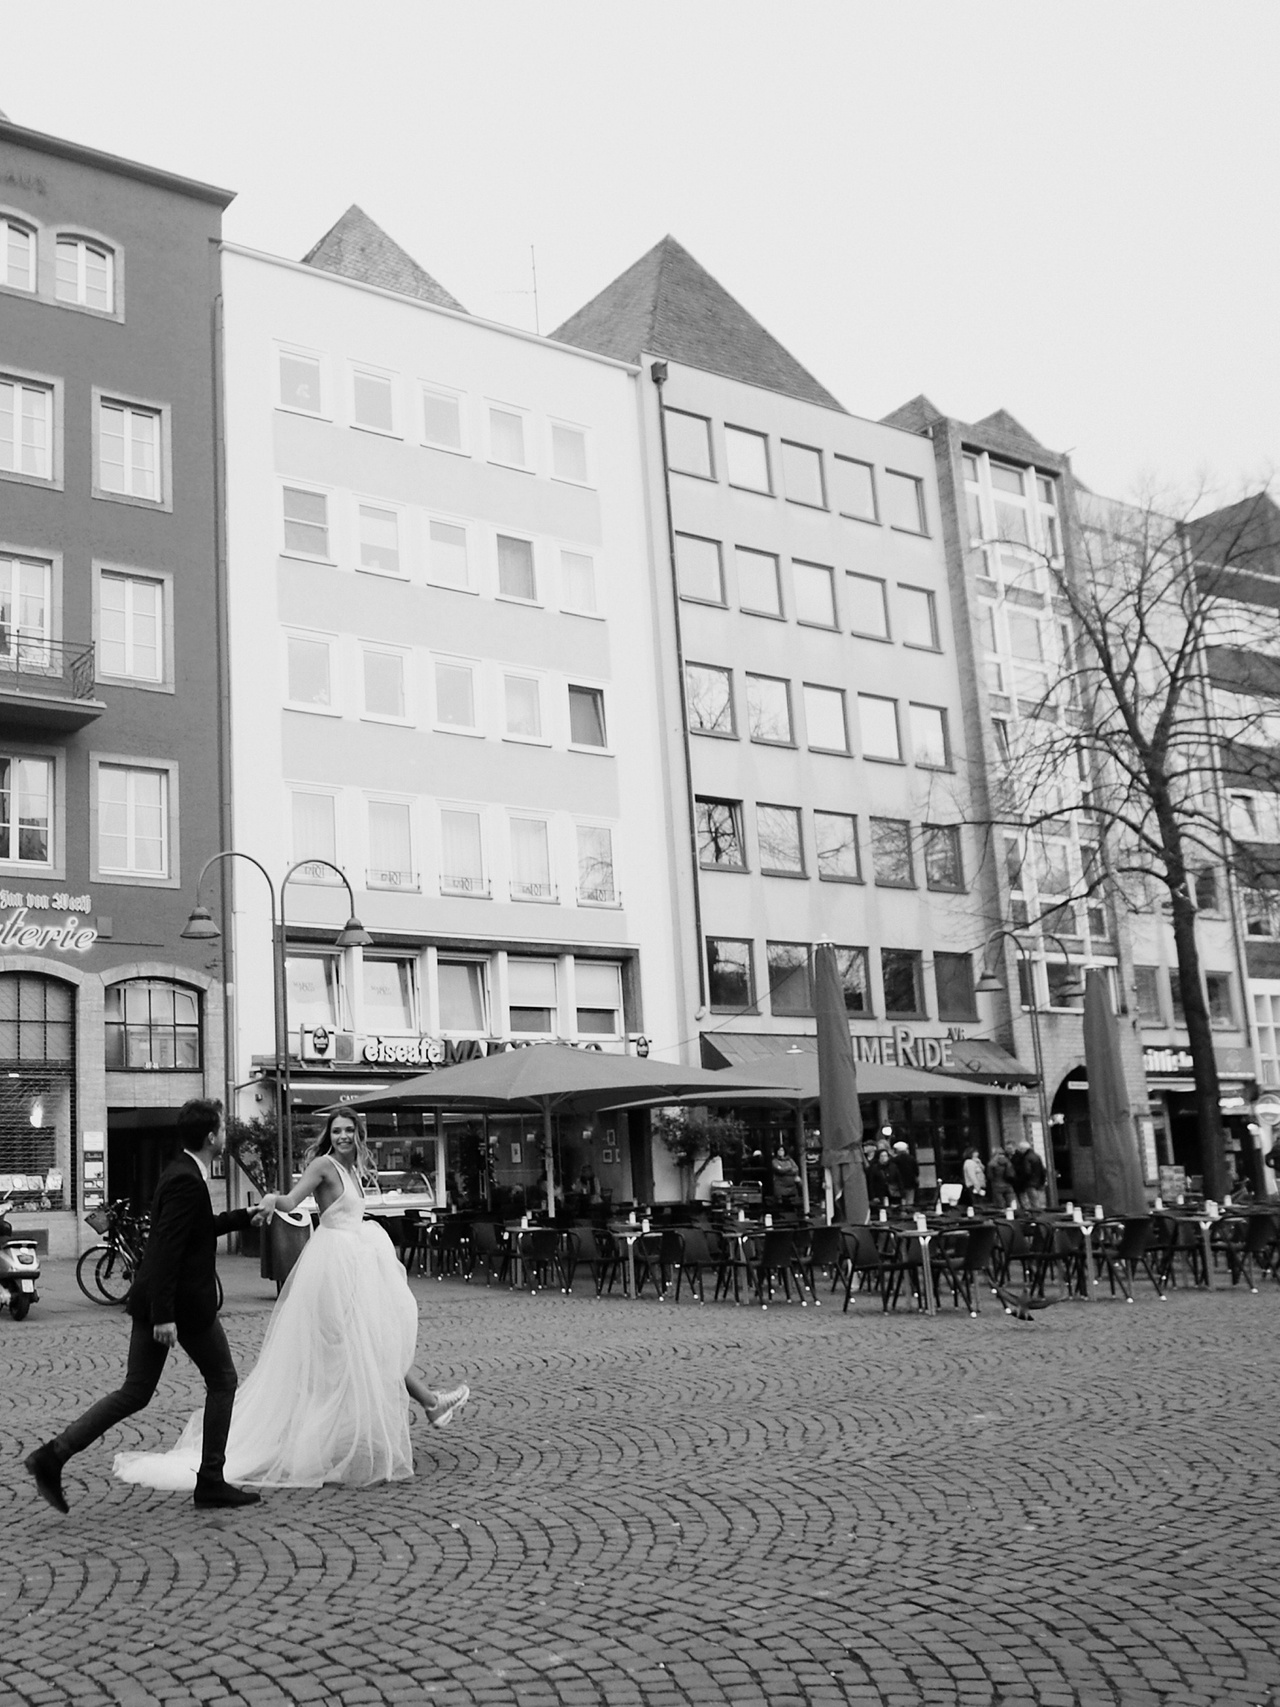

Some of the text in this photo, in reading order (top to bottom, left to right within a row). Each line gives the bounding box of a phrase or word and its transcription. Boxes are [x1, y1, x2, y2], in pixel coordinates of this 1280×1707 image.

[26, 892, 50, 910] von
[851, 1024, 955, 1067] IMERIDE
[339, 1094, 359, 1103] CAF
